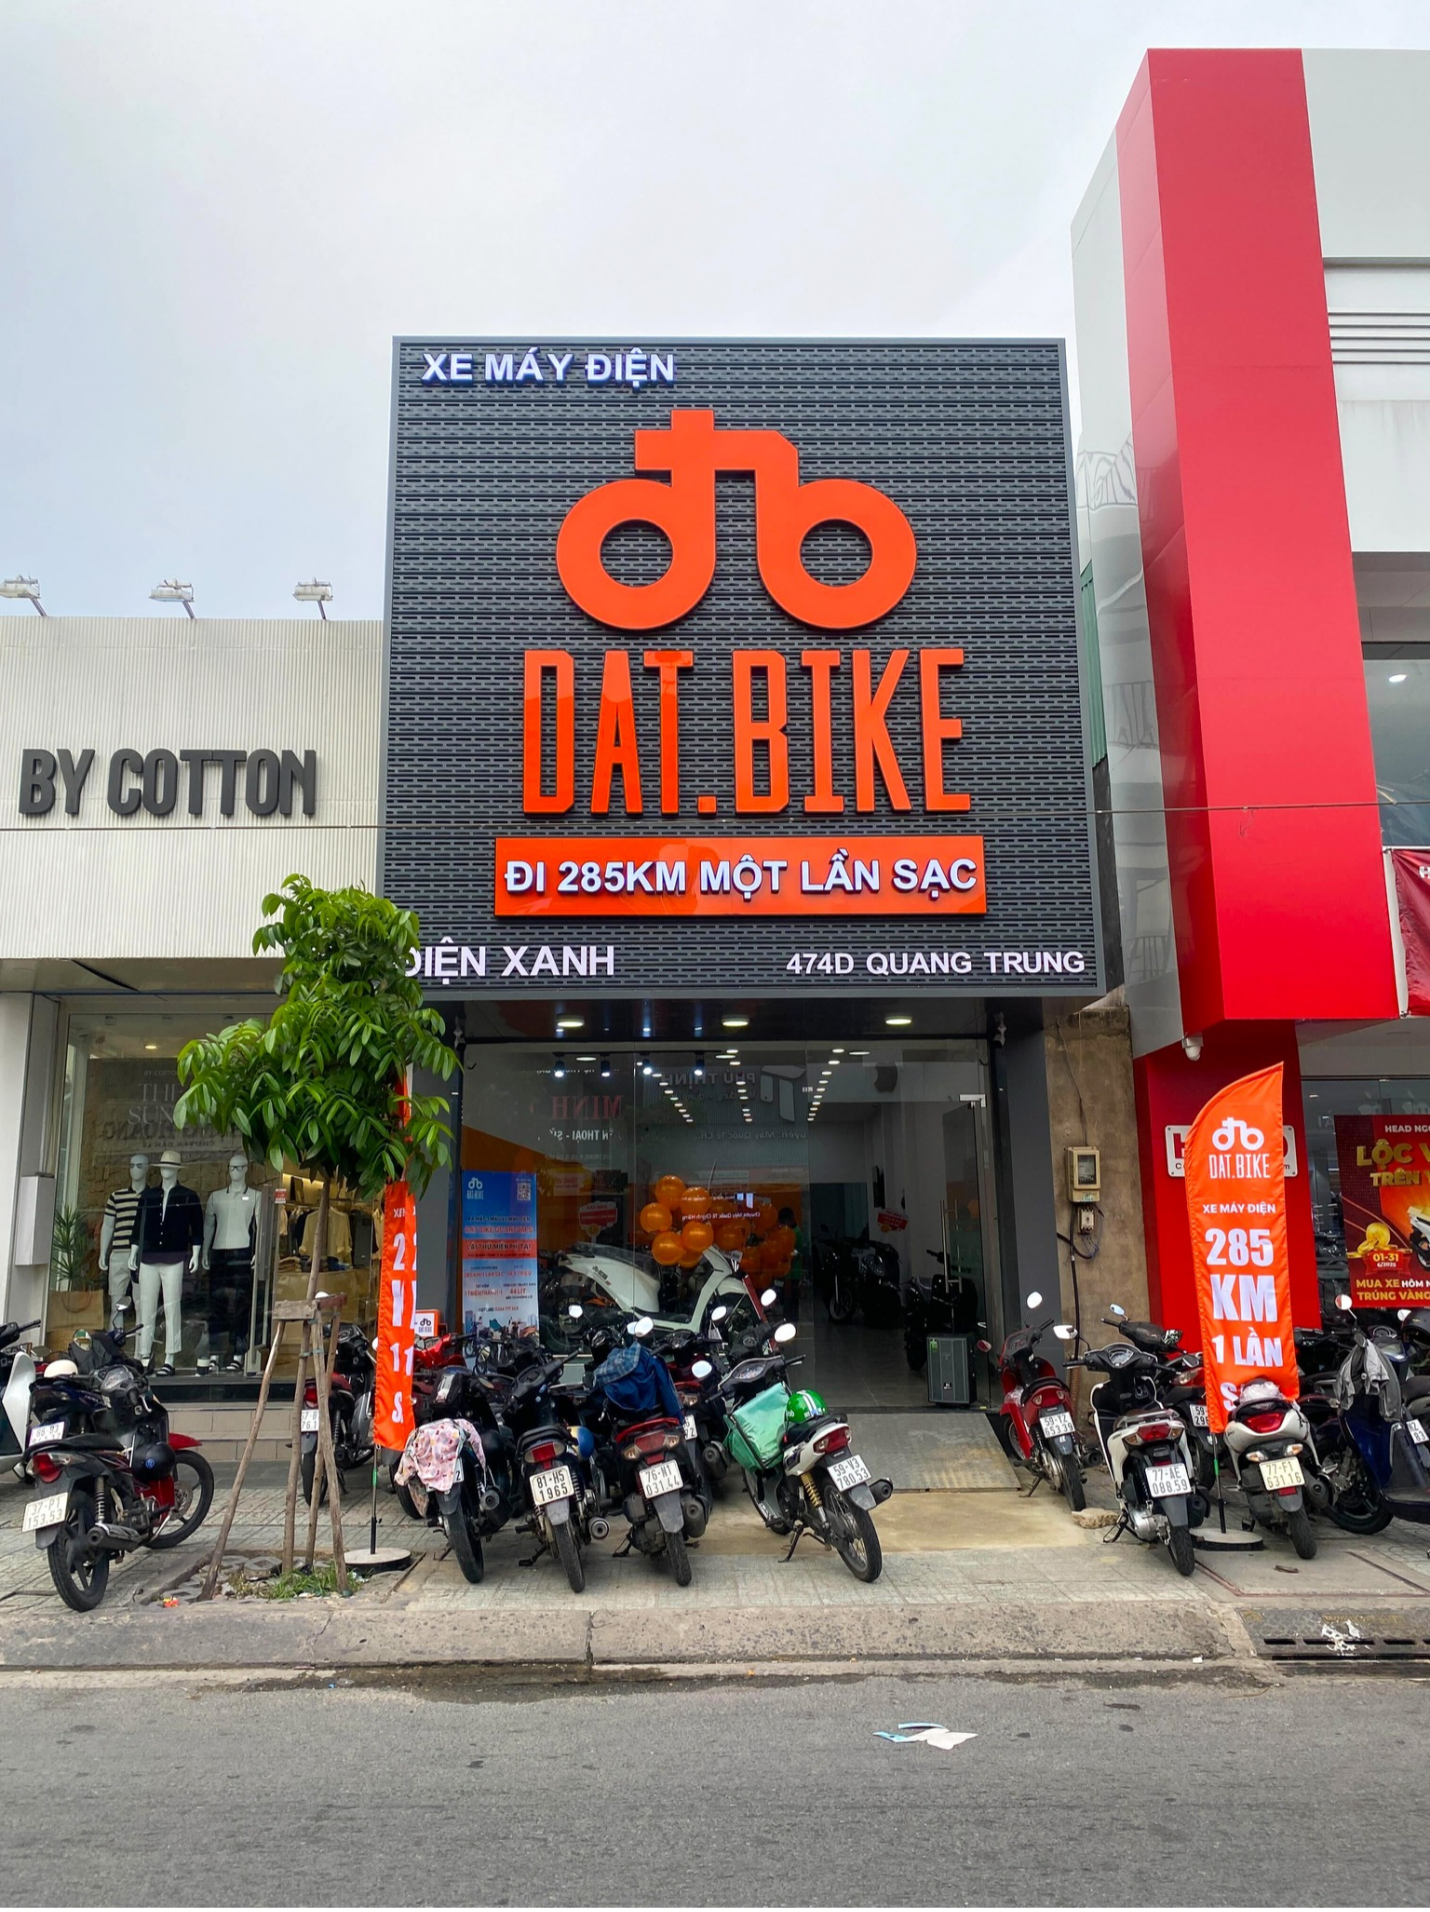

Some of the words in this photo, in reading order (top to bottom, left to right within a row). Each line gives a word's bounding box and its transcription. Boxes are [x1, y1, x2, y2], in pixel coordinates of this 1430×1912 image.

[421, 353, 474, 384] XE
[484, 346, 575, 385] MÁY
[584, 346, 676, 393] ĐIỆN
[522, 648, 972, 814] DAT.BIKE
[18, 748, 96, 816] BY
[106, 748, 317, 817] COTTON
[504, 860, 545, 893] ĐI
[557, 860, 687, 893] 285KM
[700, 853, 788, 900] MỘT
[800, 847, 880, 894] LẦN
[892, 858, 978, 900] SẠC
[501, 945, 615, 977] XANH
[786, 952, 855, 974] 474D
[866, 951, 972, 976] QUANG
[984, 951, 1086, 973] TRUNG
[1384, 1124, 1412, 1133] HEAD
[1356, 1138, 1413, 1170] LỘC
[1208, 1153, 1271, 1179] DAT.BIKE
[1369, 1167, 1421, 1187] TRÊN
[1202, 1203, 1218, 1214] XE
[1220, 1201, 1245, 1214] MÁY
[1247, 1200, 1276, 1216] ĐIỆN
[1204, 1227, 1274, 1267] 285
[1372, 1252, 1399, 1263] 01-31
[1356, 1278, 1382, 1288] MUA
[1385, 1278, 1400, 1288] XE
[1402, 1277, 1424, 1288] HÔM
[1209, 1273, 1278, 1324] KM
[1357, 1287, 1397, 1301] TRÚNG
[1212, 1336, 1225, 1364] 1
[644, 1464, 673, 1483] 76-N1
[832, 1456, 861, 1477] 59-V3
[1152, 1466, 1182, 1482] 77-AE
[1265, 1460, 1295, 1476] 77-F1
[536, 1469, 566, 1490] 81-H5
[1151, 1479, 1189, 1496] 088.59
[1266, 1471, 1302, 1488] 631.16
[539, 1483, 569, 1503] 1965
